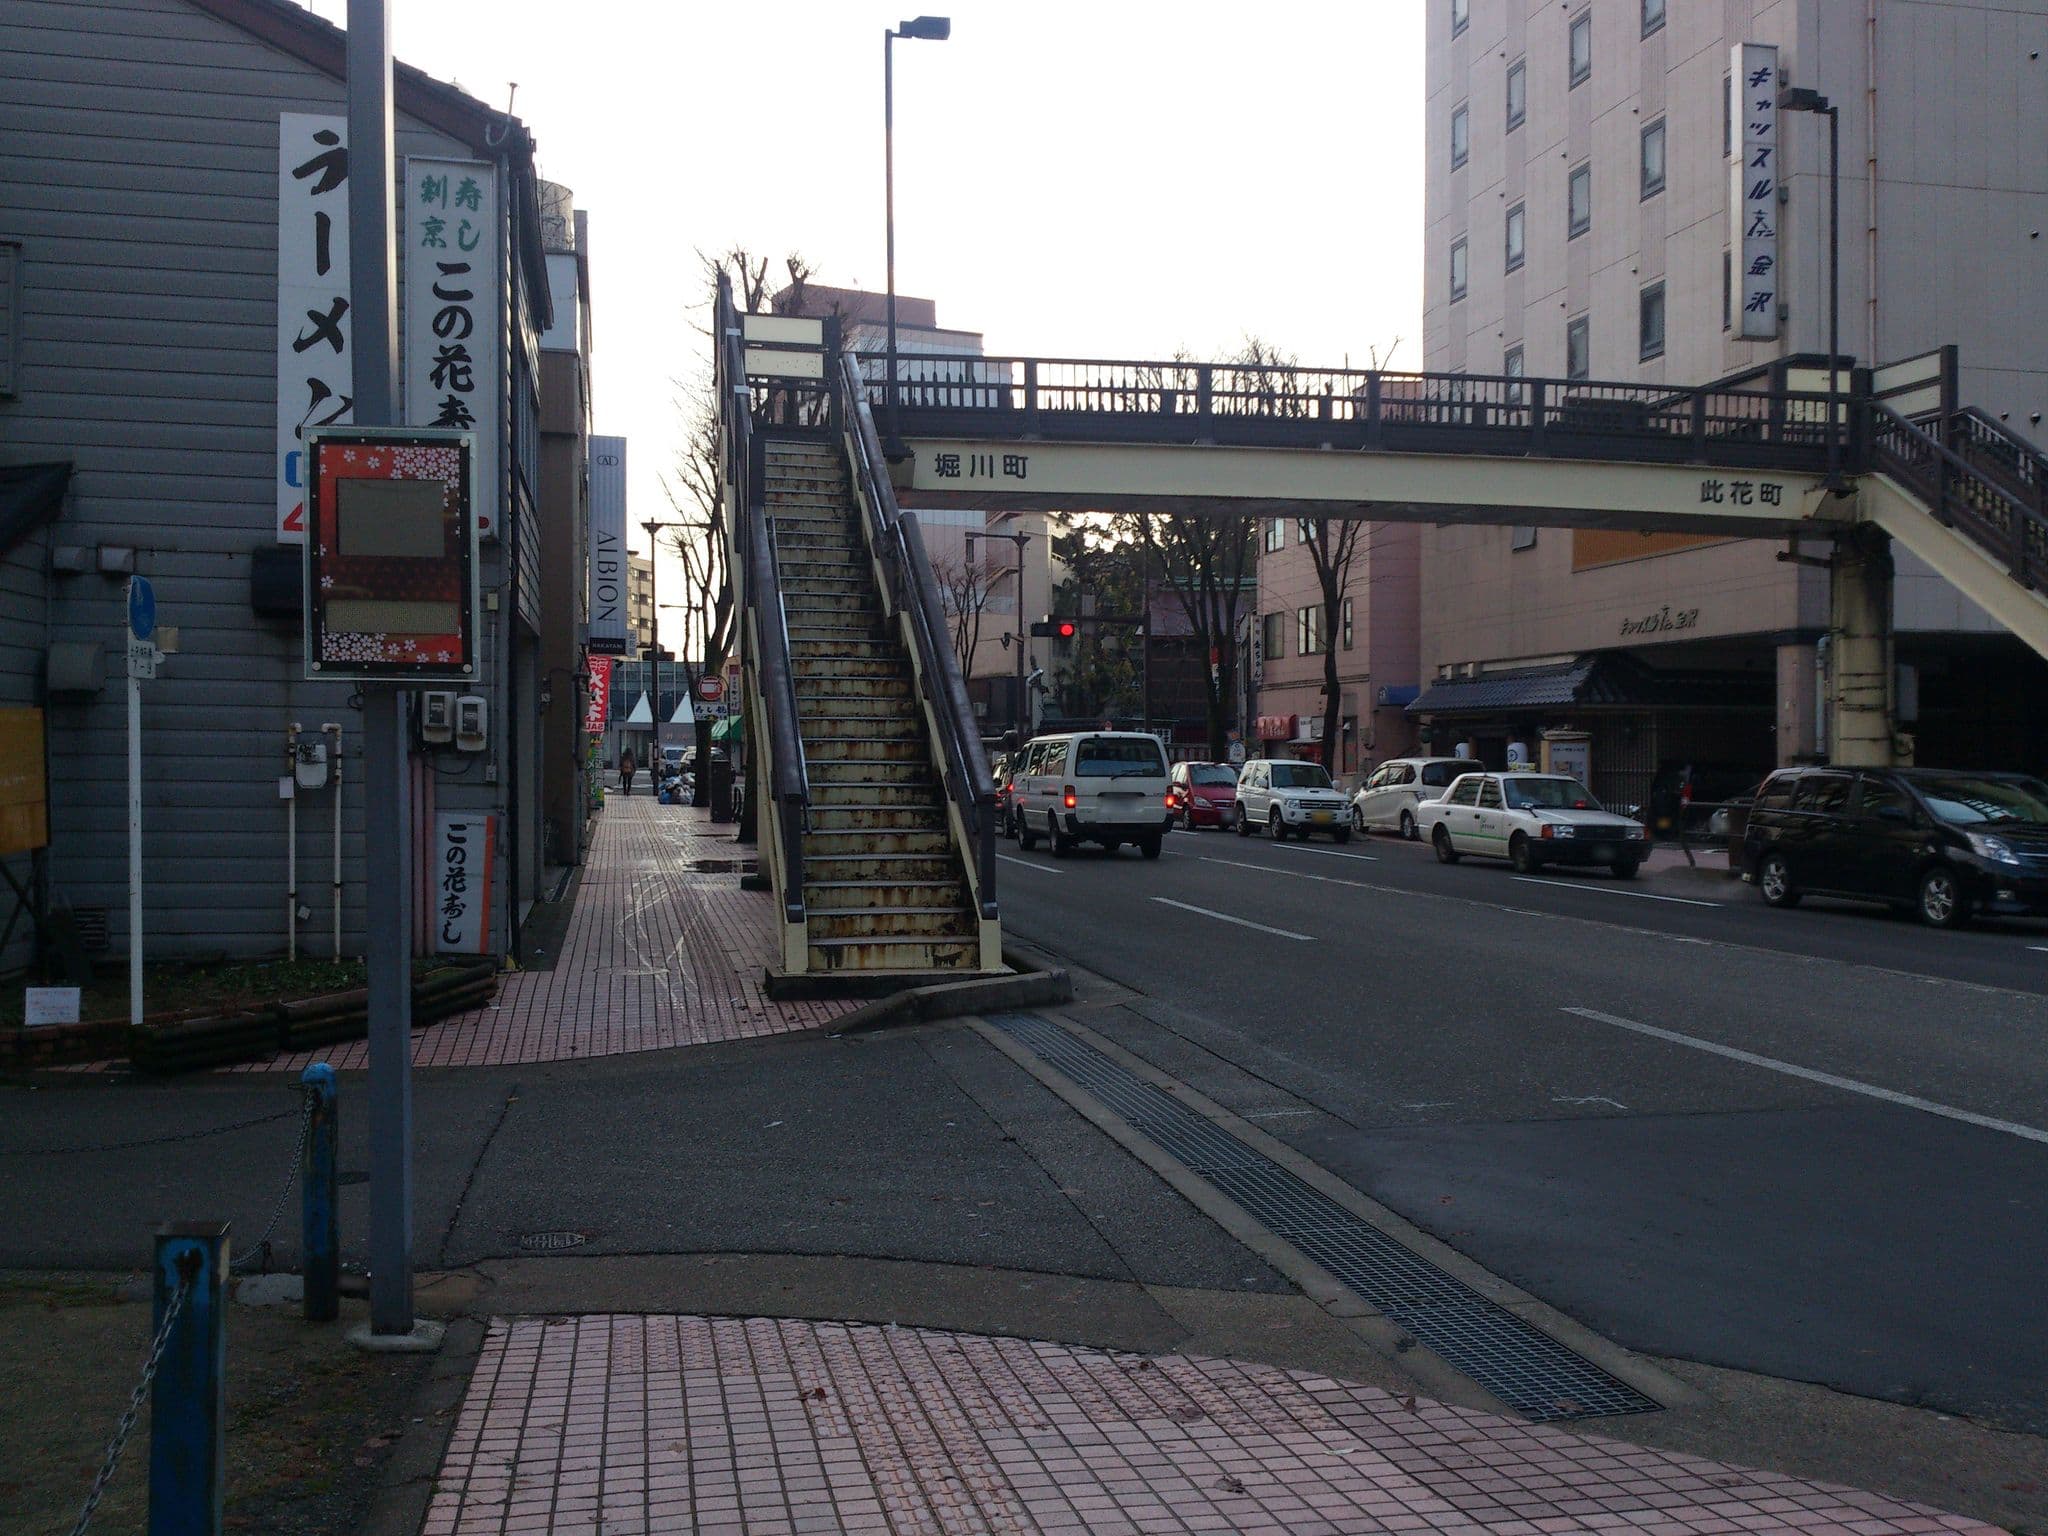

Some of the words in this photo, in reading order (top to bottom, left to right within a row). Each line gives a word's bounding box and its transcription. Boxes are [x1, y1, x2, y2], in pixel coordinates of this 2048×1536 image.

[935, 453, 1028, 479] 堀川町
[1701, 479, 1784, 506] 此花町
[597, 530, 619, 621] ALBION
[442, 823, 467, 944] この花寿し
